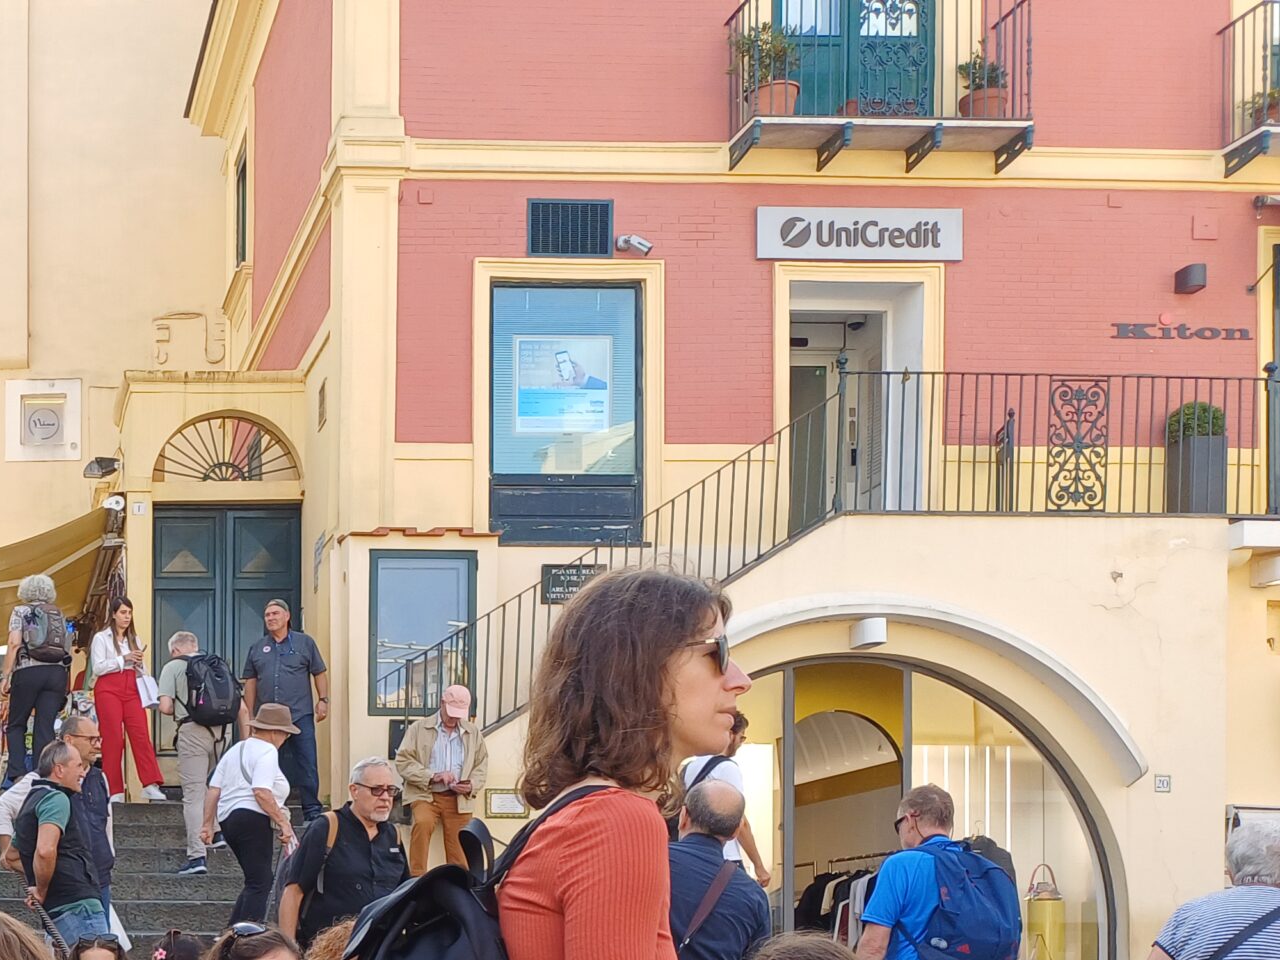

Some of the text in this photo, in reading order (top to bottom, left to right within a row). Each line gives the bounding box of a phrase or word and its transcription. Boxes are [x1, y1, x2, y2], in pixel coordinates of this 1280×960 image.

[816, 220, 941, 248] UniCredit
[1110, 312, 1254, 341] Kiton
[1157, 778, 1169, 789] 20
